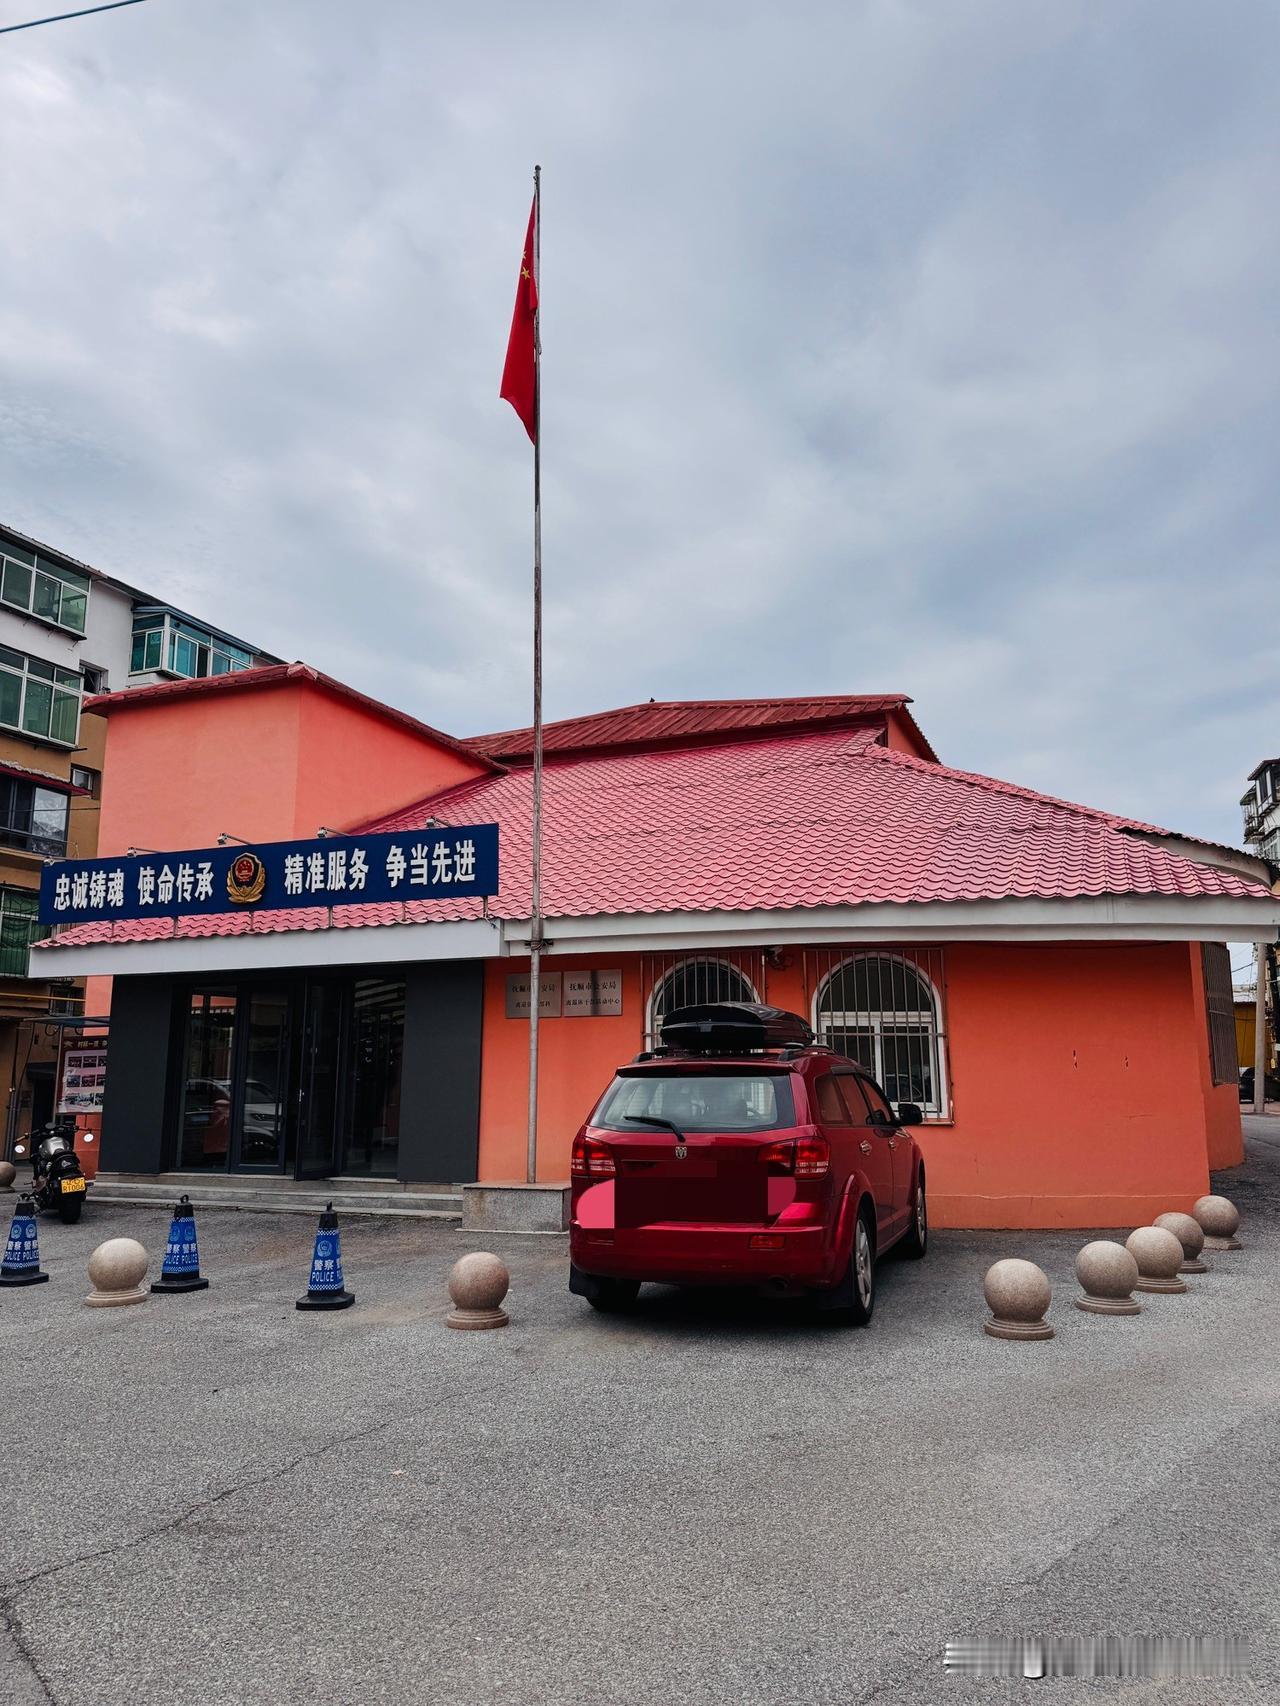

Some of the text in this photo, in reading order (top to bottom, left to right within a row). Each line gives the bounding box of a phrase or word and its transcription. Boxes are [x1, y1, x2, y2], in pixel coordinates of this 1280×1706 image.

[53, 839, 476, 911] 忠诚铸魂 使命传承 精准服务 争当先进
[314, 1259, 334, 1271] 警察
[311, 1271, 335, 1282] POLICE
